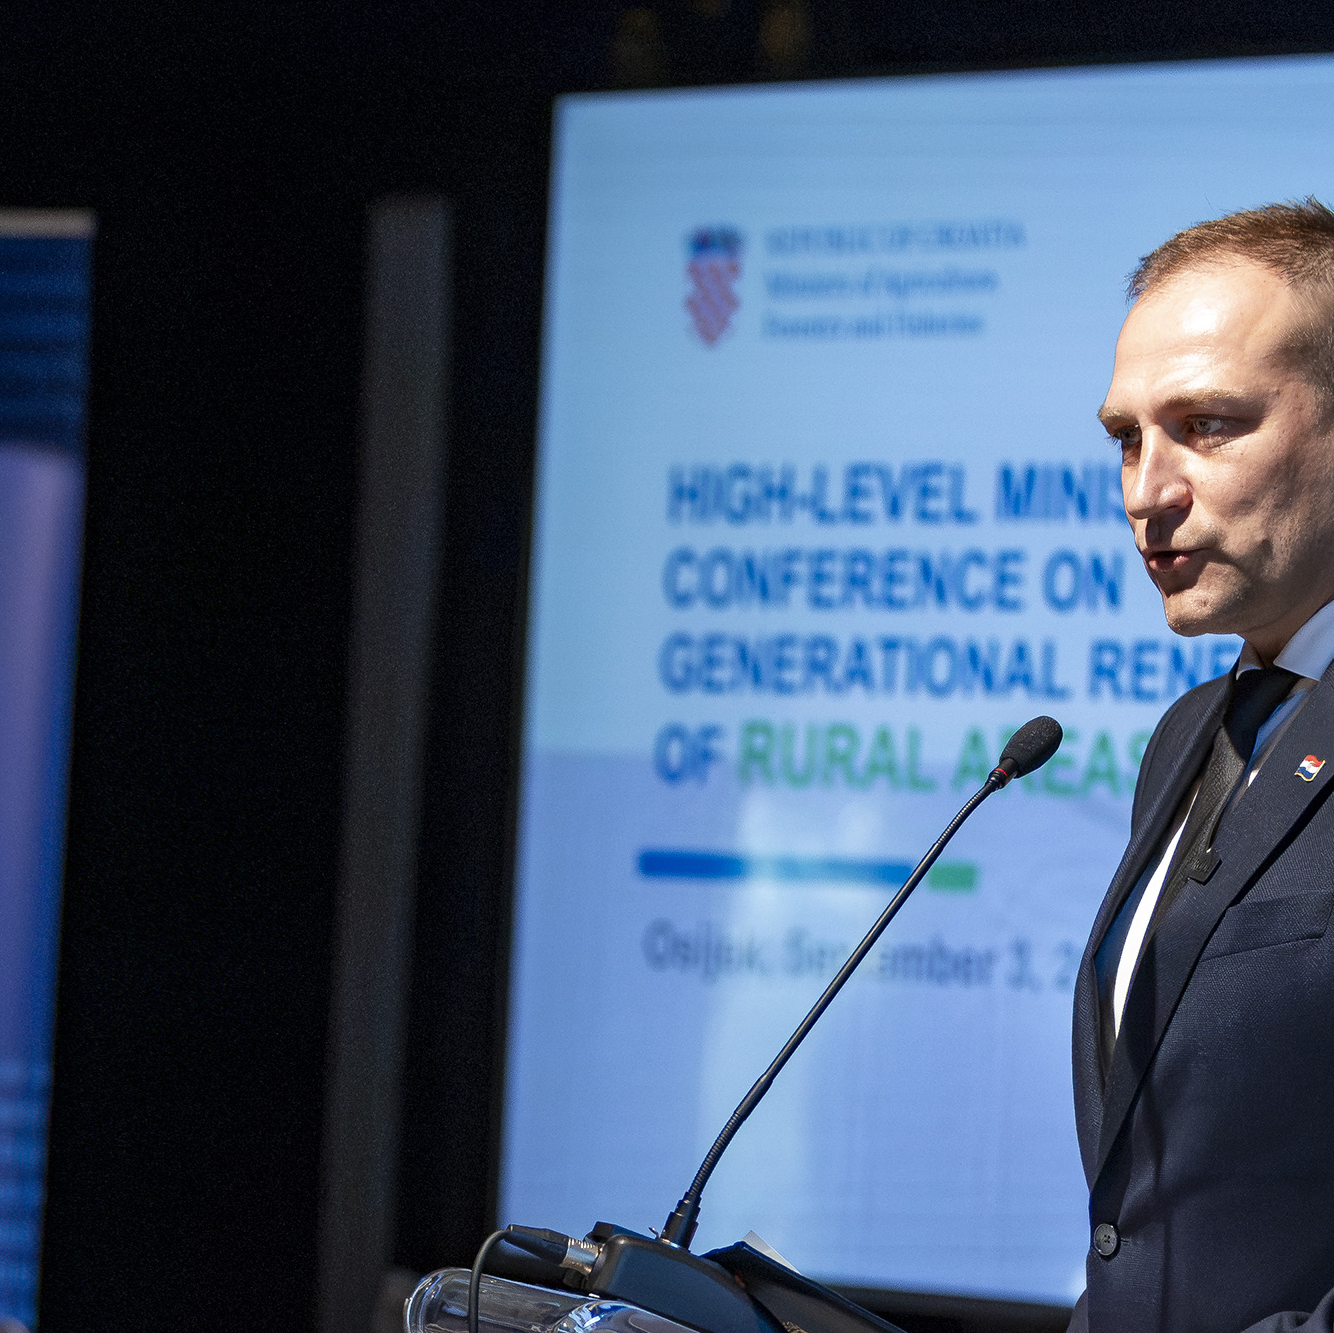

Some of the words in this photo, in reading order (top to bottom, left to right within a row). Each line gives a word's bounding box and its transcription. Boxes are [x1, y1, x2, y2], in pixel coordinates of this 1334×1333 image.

[668, 462, 976, 527] HIGH-LEVEL
[663, 546, 1025, 614] CONFERENCE
[1041, 547, 1126, 614] ON
[658, 633, 1071, 699] GENERATIONAL
[653, 722, 727, 784] OF
[738, 719, 937, 792] RURAL
